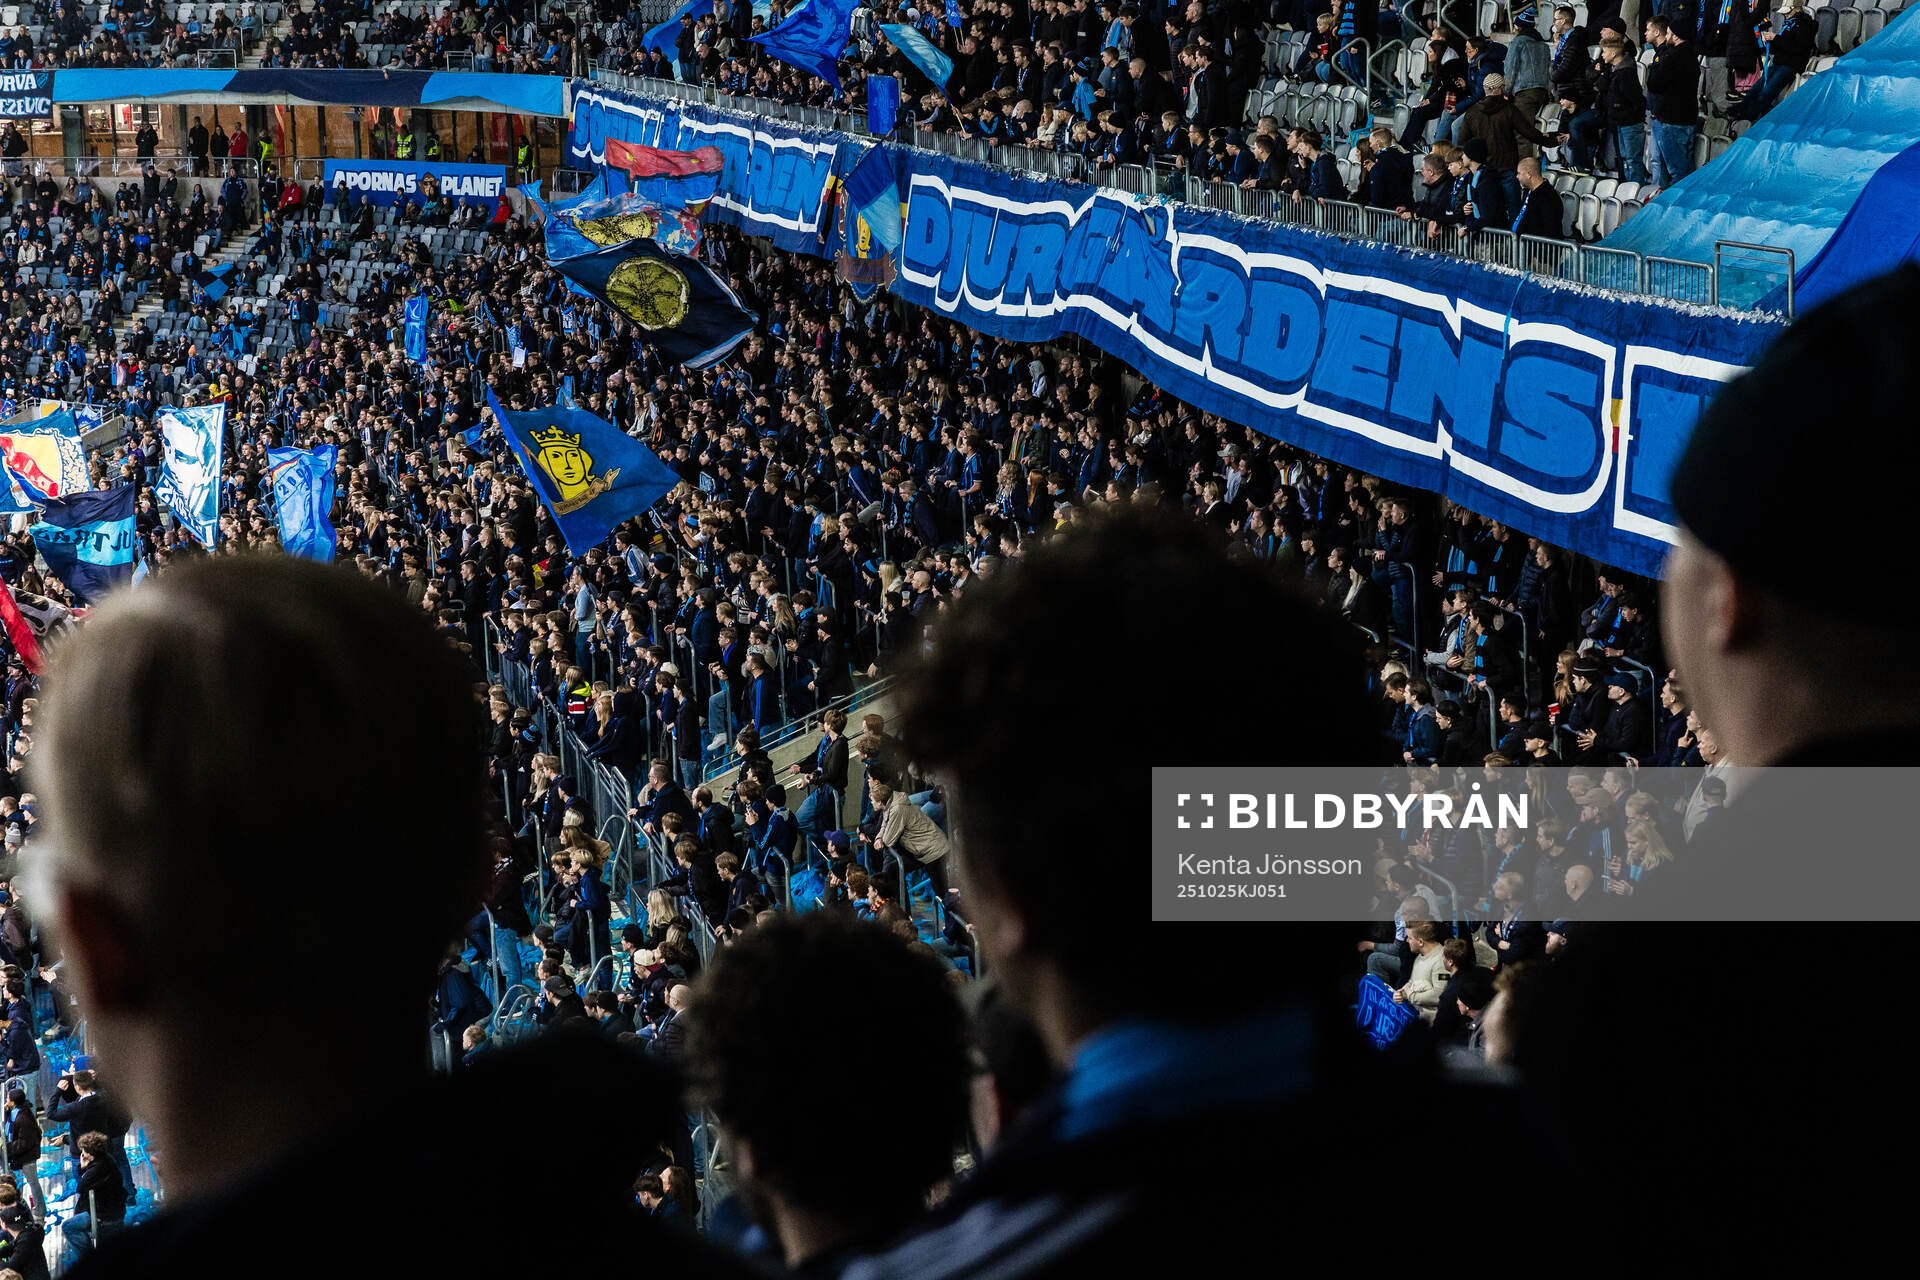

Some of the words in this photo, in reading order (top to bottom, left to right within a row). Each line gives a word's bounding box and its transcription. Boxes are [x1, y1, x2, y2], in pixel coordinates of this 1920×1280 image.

[0, 73, 37, 92] RVA
[333, 170, 417, 194] APORNAS
[440, 175, 503, 197] PLANET
[902, 174, 1617, 513] DJURGÅRDENS
